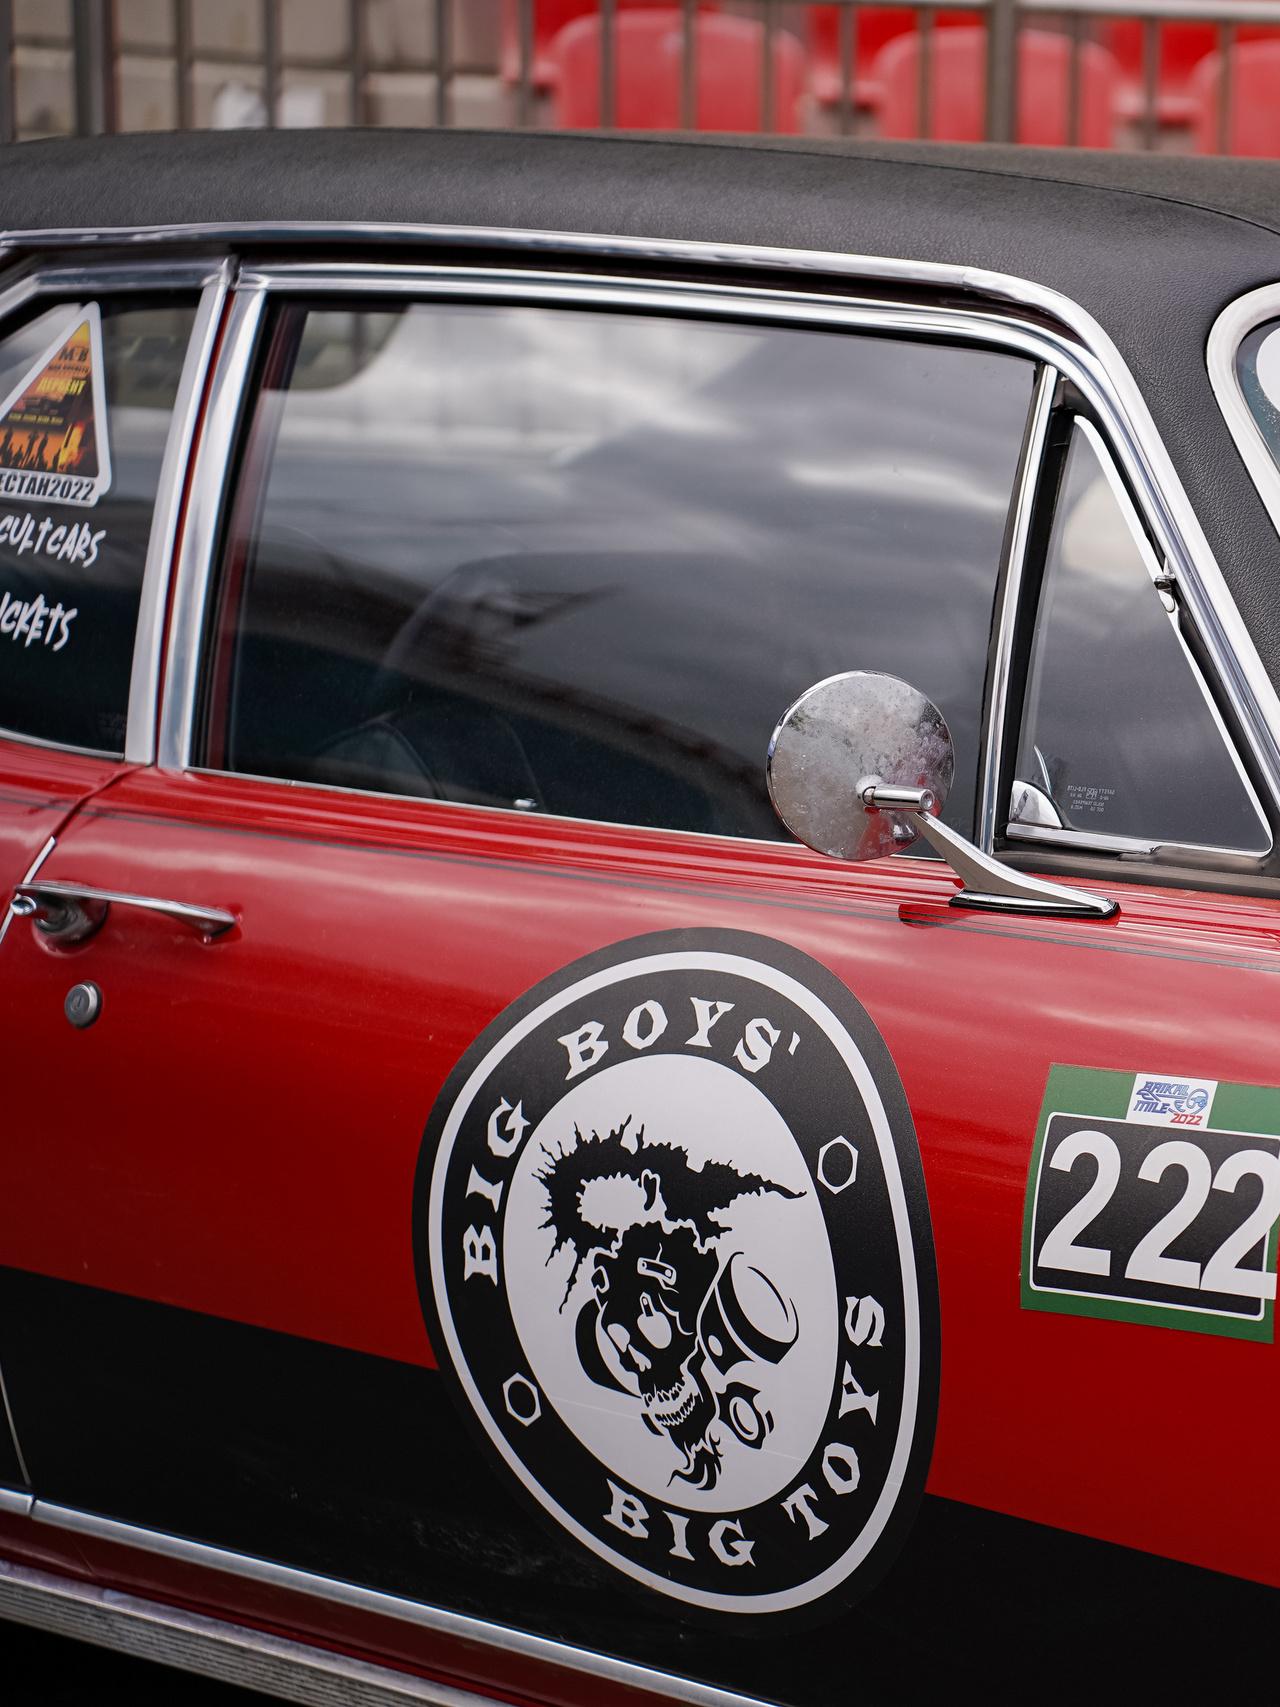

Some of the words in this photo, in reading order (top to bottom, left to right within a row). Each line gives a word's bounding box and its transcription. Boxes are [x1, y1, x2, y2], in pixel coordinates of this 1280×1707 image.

[1141, 1081, 1190, 1096] BAIKAL
[1133, 1100, 1170, 1114] MILE
[1170, 1113, 1203, 1126] 2022
[462, 1097, 531, 1287] BIG
[557, 996, 801, 1081] BOYS'
[602, 1478, 756, 1568] BIG
[781, 1295, 885, 1541] TOYS
